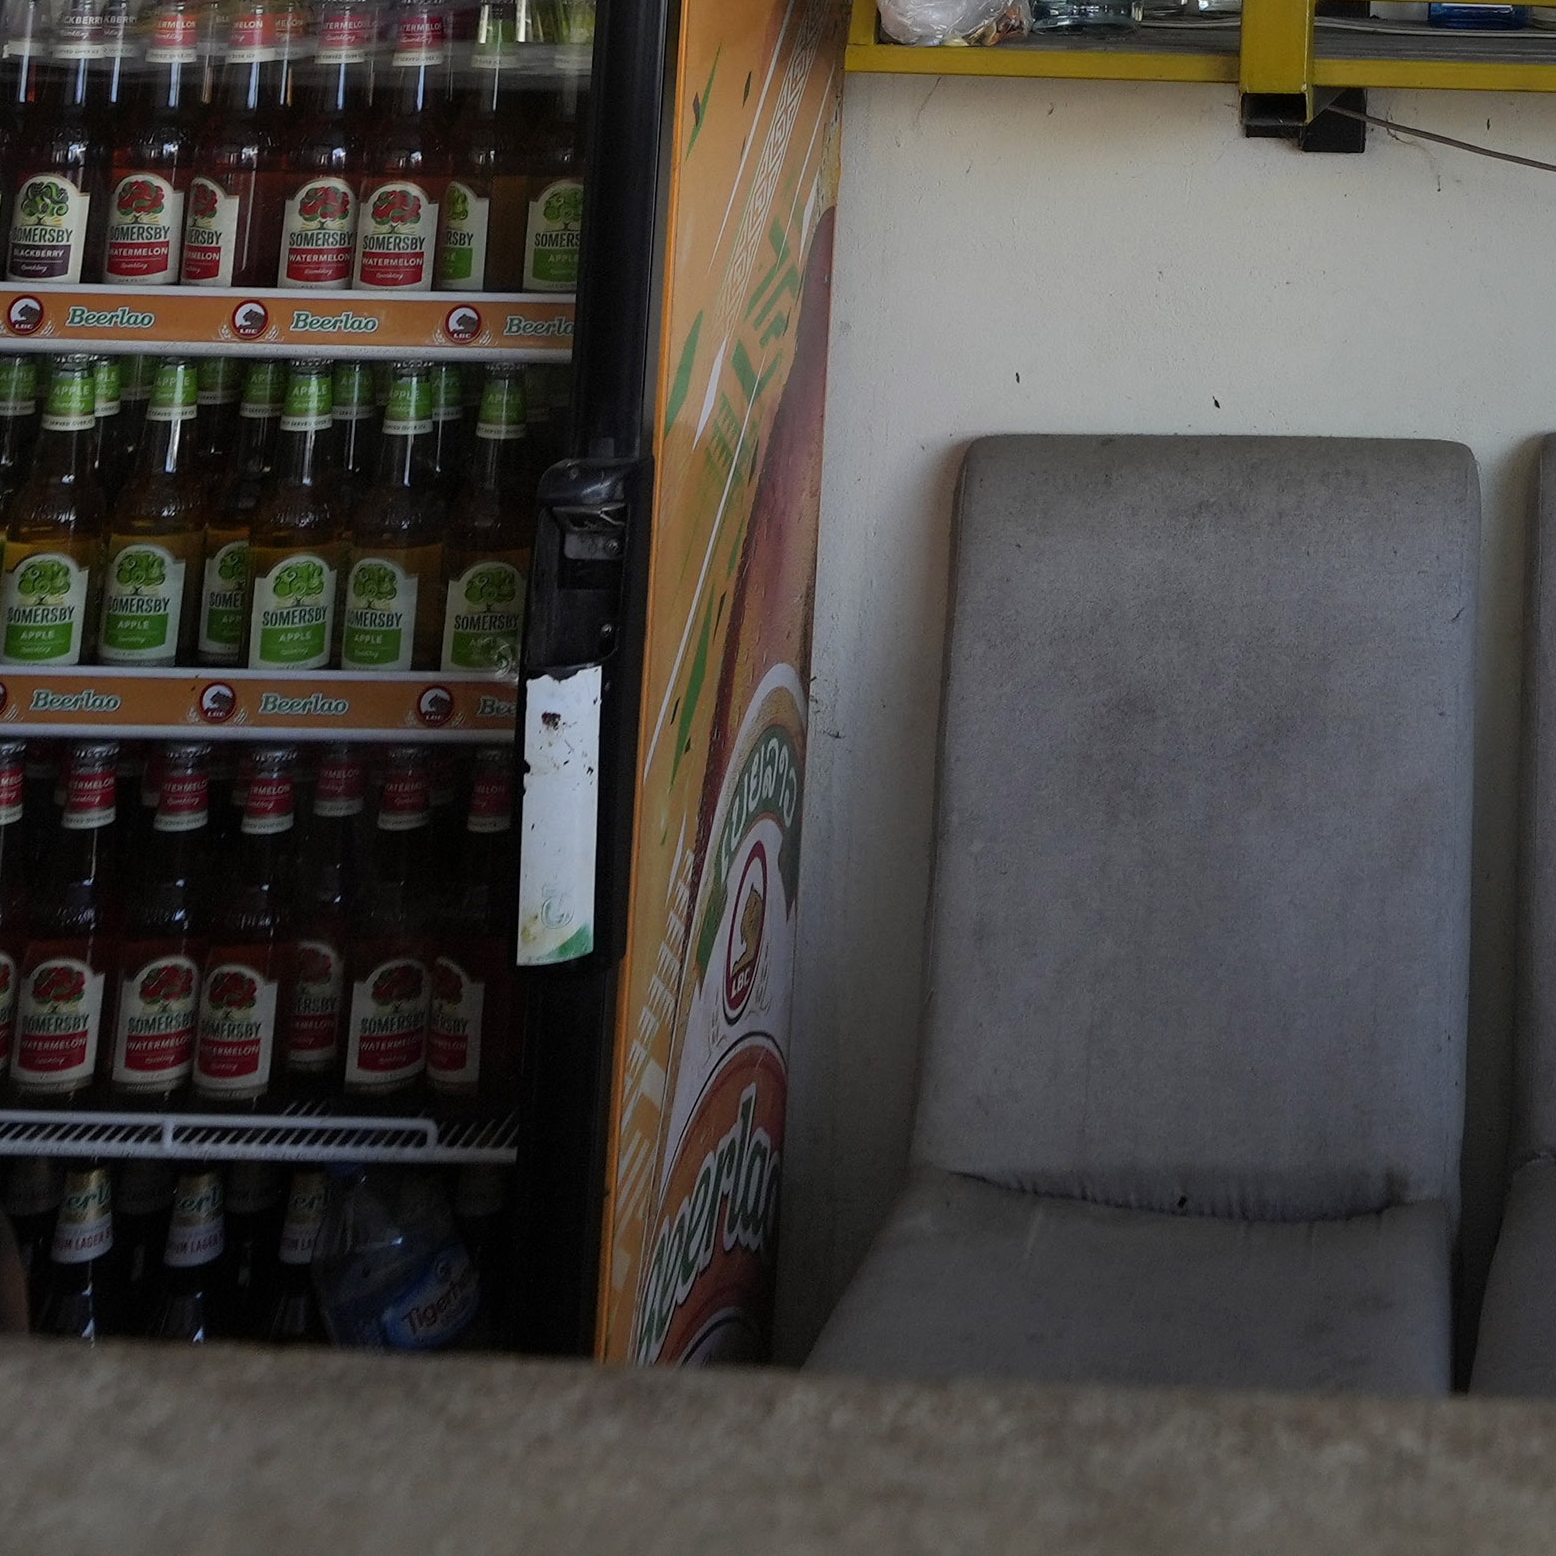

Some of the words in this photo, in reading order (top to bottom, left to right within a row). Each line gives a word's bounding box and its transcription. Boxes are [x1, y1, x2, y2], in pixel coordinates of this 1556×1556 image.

[289, 231, 353, 248] SOMERSBY
[362, 233, 426, 251] SOMERSBY
[361, 256, 424, 267] WATERMELON
[65, 305, 156, 331] Beerlao
[290, 311, 380, 336] Beerlao
[7, 605, 76, 625] SOMERSBY
[261, 605, 329, 626] SOMERSBY
[453, 613, 520, 632] SOMERSBY
[20, 630, 56, 642] APPLE
[277, 631, 313, 644] APPLE
[28, 690, 121, 715] Beerlao
[257, 692, 350, 719] Beerlao
